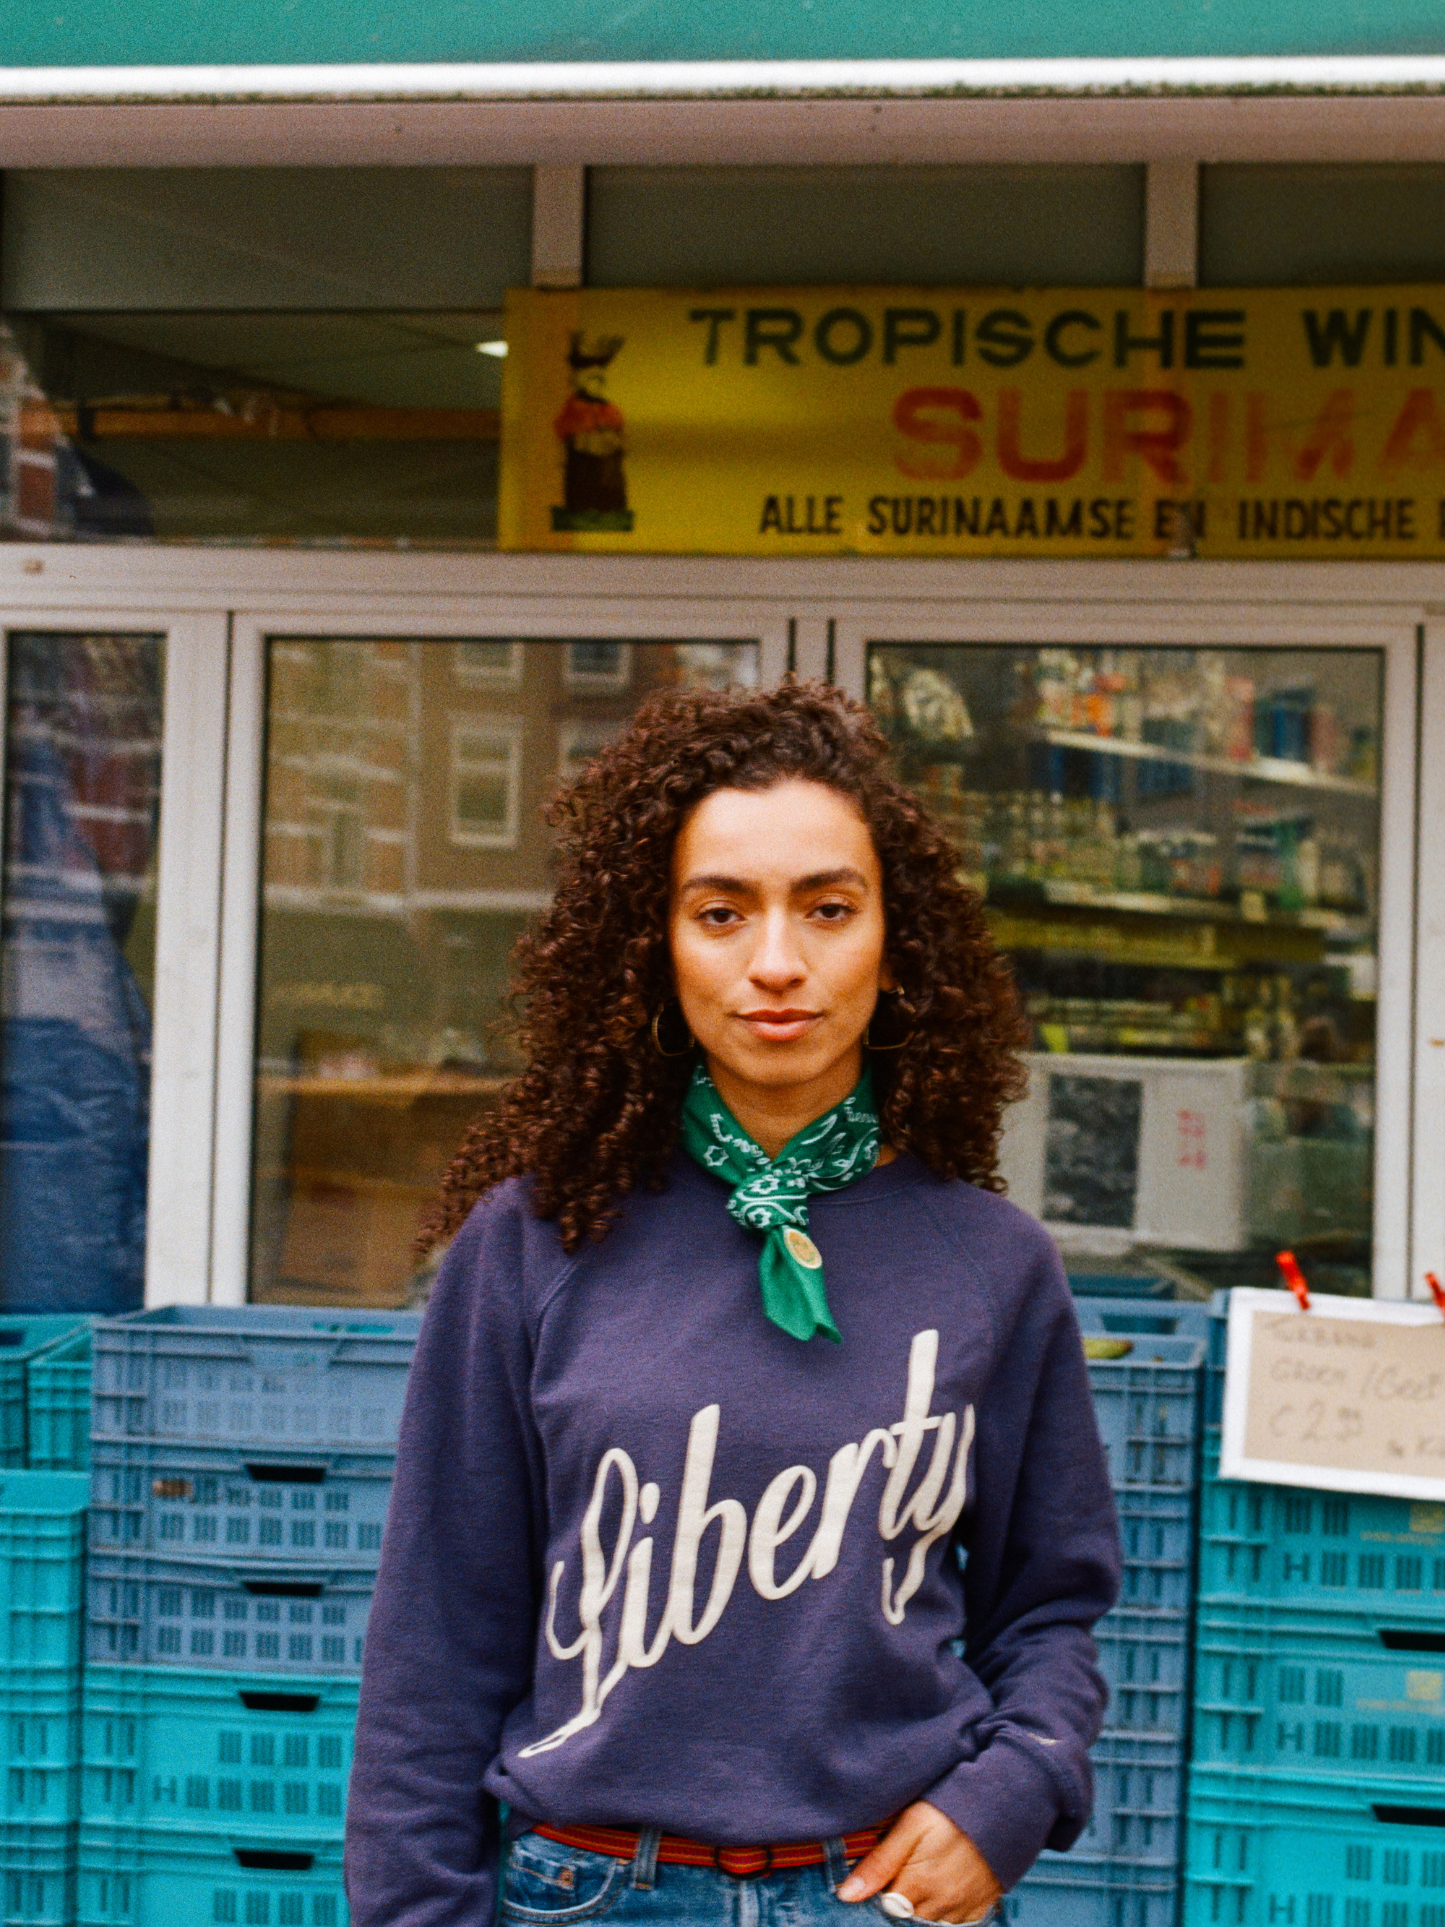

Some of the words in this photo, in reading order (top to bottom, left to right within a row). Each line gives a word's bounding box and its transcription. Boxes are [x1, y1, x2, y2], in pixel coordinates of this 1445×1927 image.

[688, 307, 1246, 368] TROPISCHE
[759, 496, 845, 536] ALLE
[867, 496, 1134, 538] SURINAAMSE
[1238, 499, 1416, 540] INDISCHE
[518, 1329, 976, 1757] Liberty
